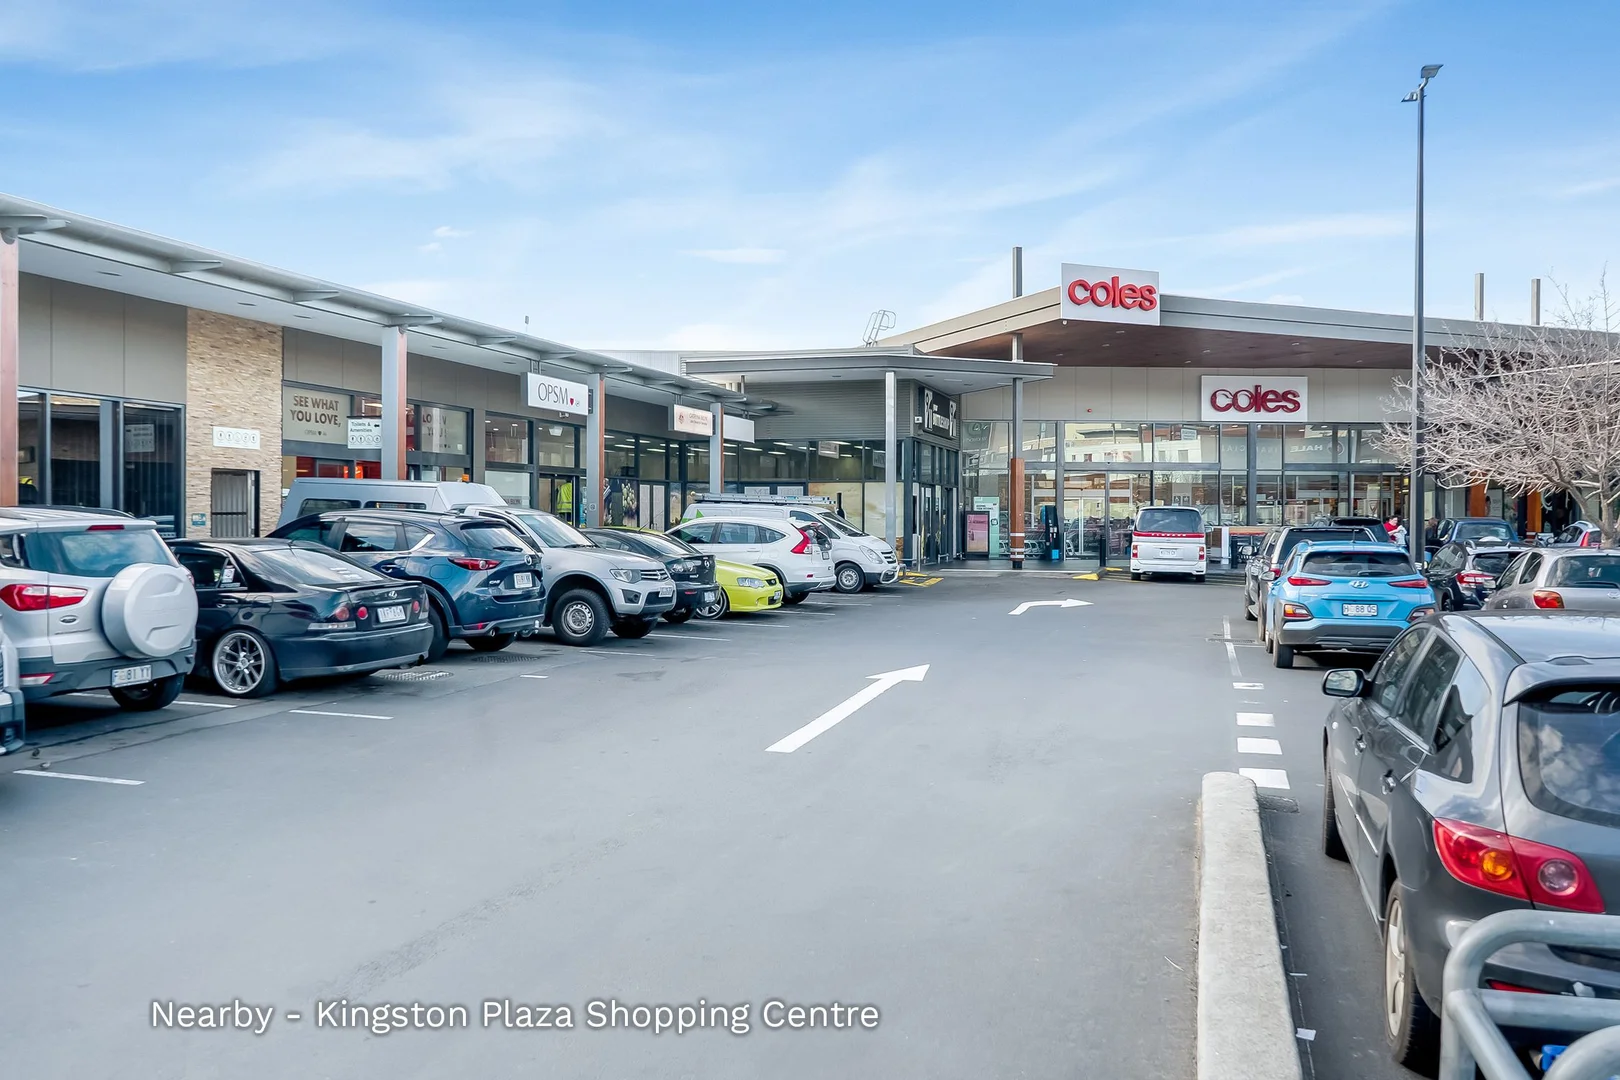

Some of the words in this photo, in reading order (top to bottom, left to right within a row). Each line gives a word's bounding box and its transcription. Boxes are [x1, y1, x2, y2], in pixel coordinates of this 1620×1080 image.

[1068, 276, 1158, 311] coles
[293, 395, 309, 408] SEE
[311, 397, 339, 411] WHAT
[537, 382, 569, 405] OPSM
[1210, 385, 1301, 413] coles
[290, 409, 312, 423] YOU
[314, 412, 342, 428] LOVE,
